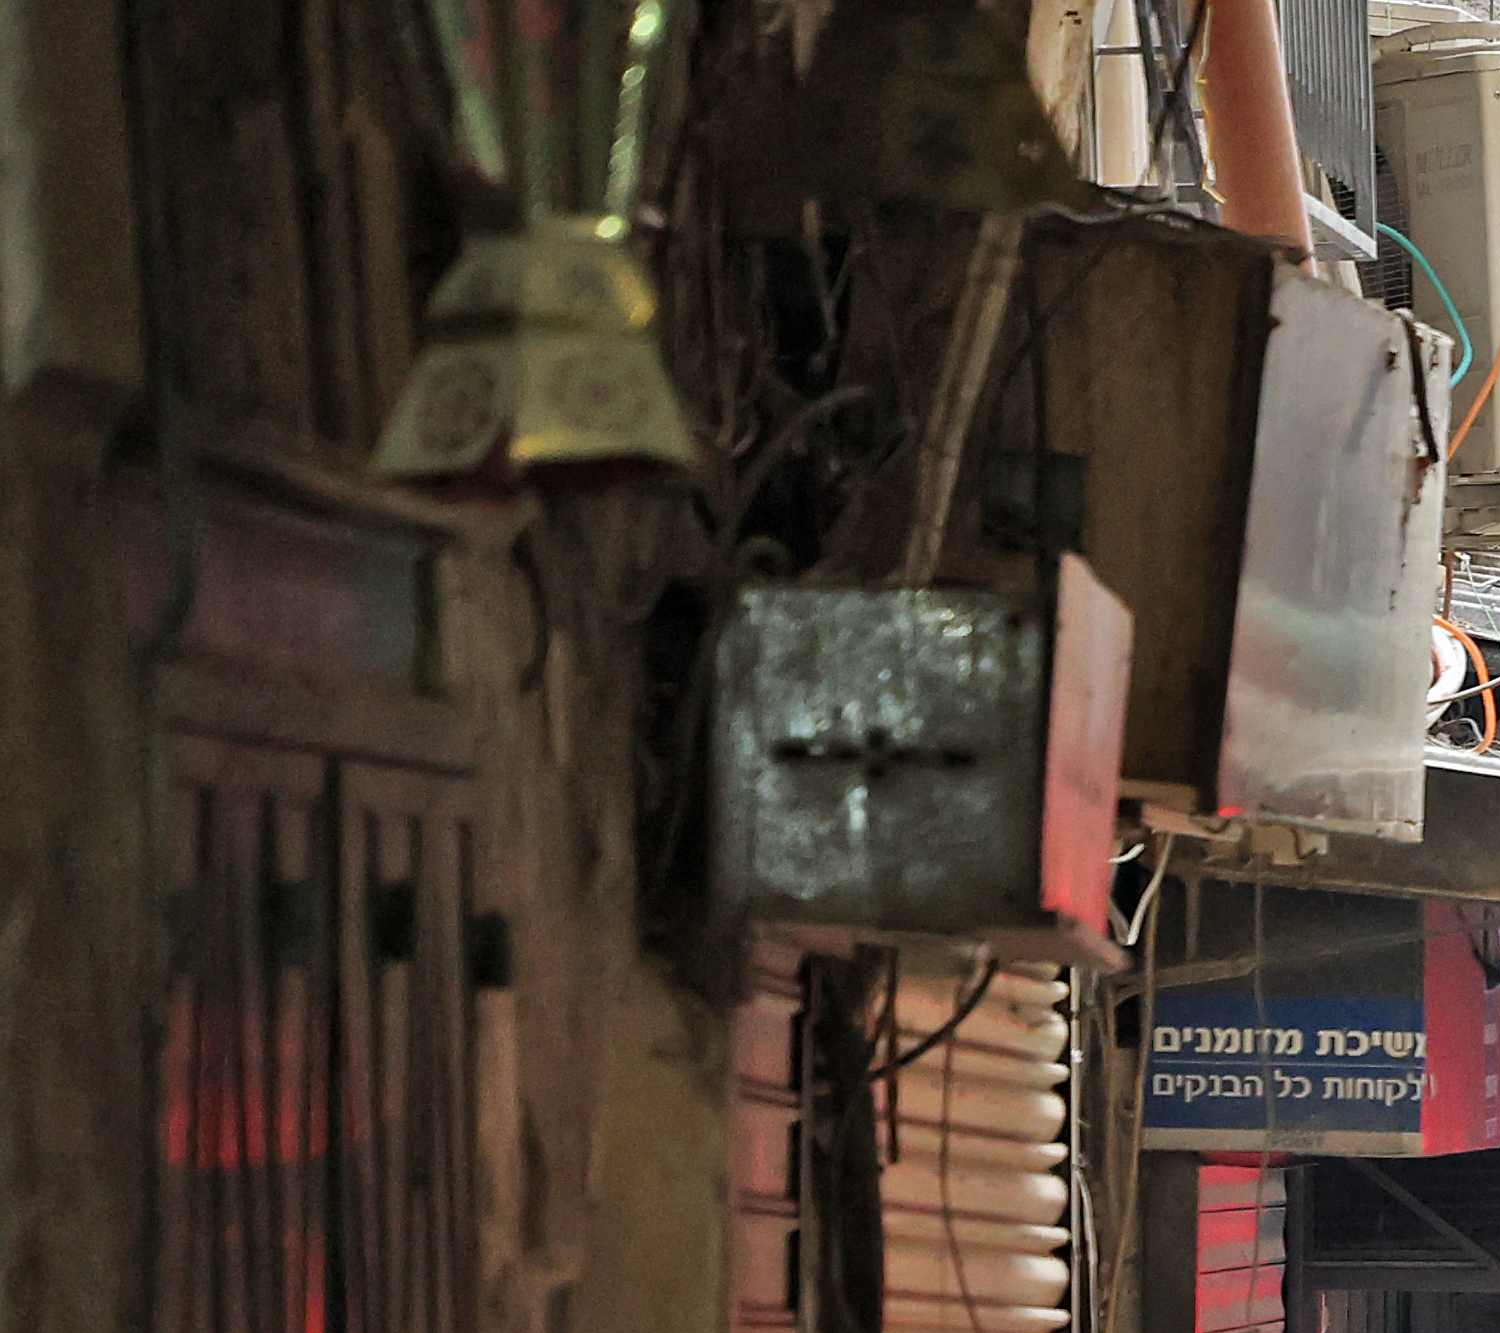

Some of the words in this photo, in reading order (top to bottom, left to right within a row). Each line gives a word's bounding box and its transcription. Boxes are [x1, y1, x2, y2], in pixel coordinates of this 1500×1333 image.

[1153, 1026, 1304, 1055] מזומנים
[1152, 1072, 1264, 1103] הבנקים
[1273, 1069, 1313, 1098] כל
